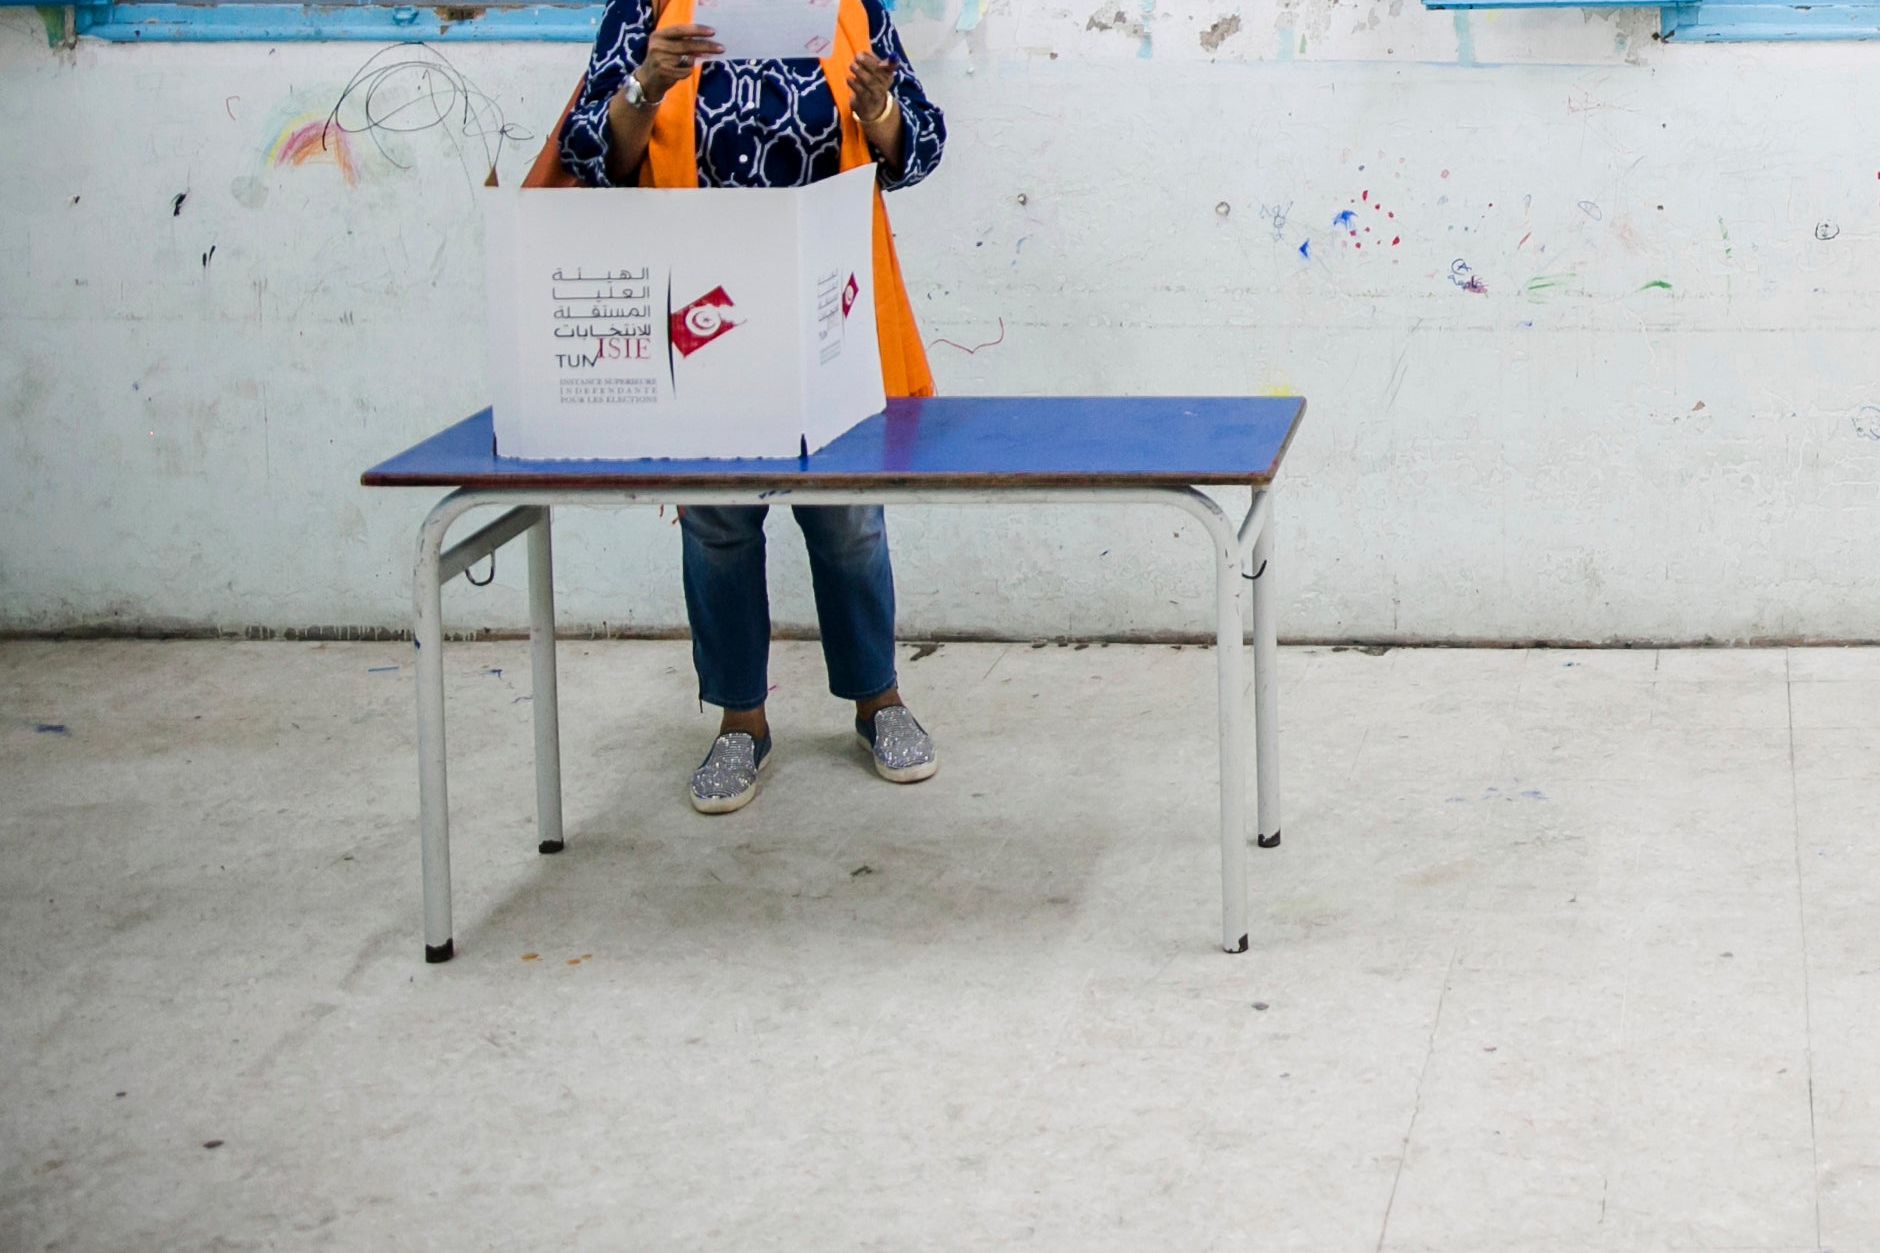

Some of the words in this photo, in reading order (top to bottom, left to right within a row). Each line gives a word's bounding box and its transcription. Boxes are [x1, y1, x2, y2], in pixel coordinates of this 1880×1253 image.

[552, 266, 649, 283] الهيئة
[553, 286, 650, 302] العليا
[553, 305, 651, 319] المستقلة
[554, 323, 651, 340] للانتخابات
